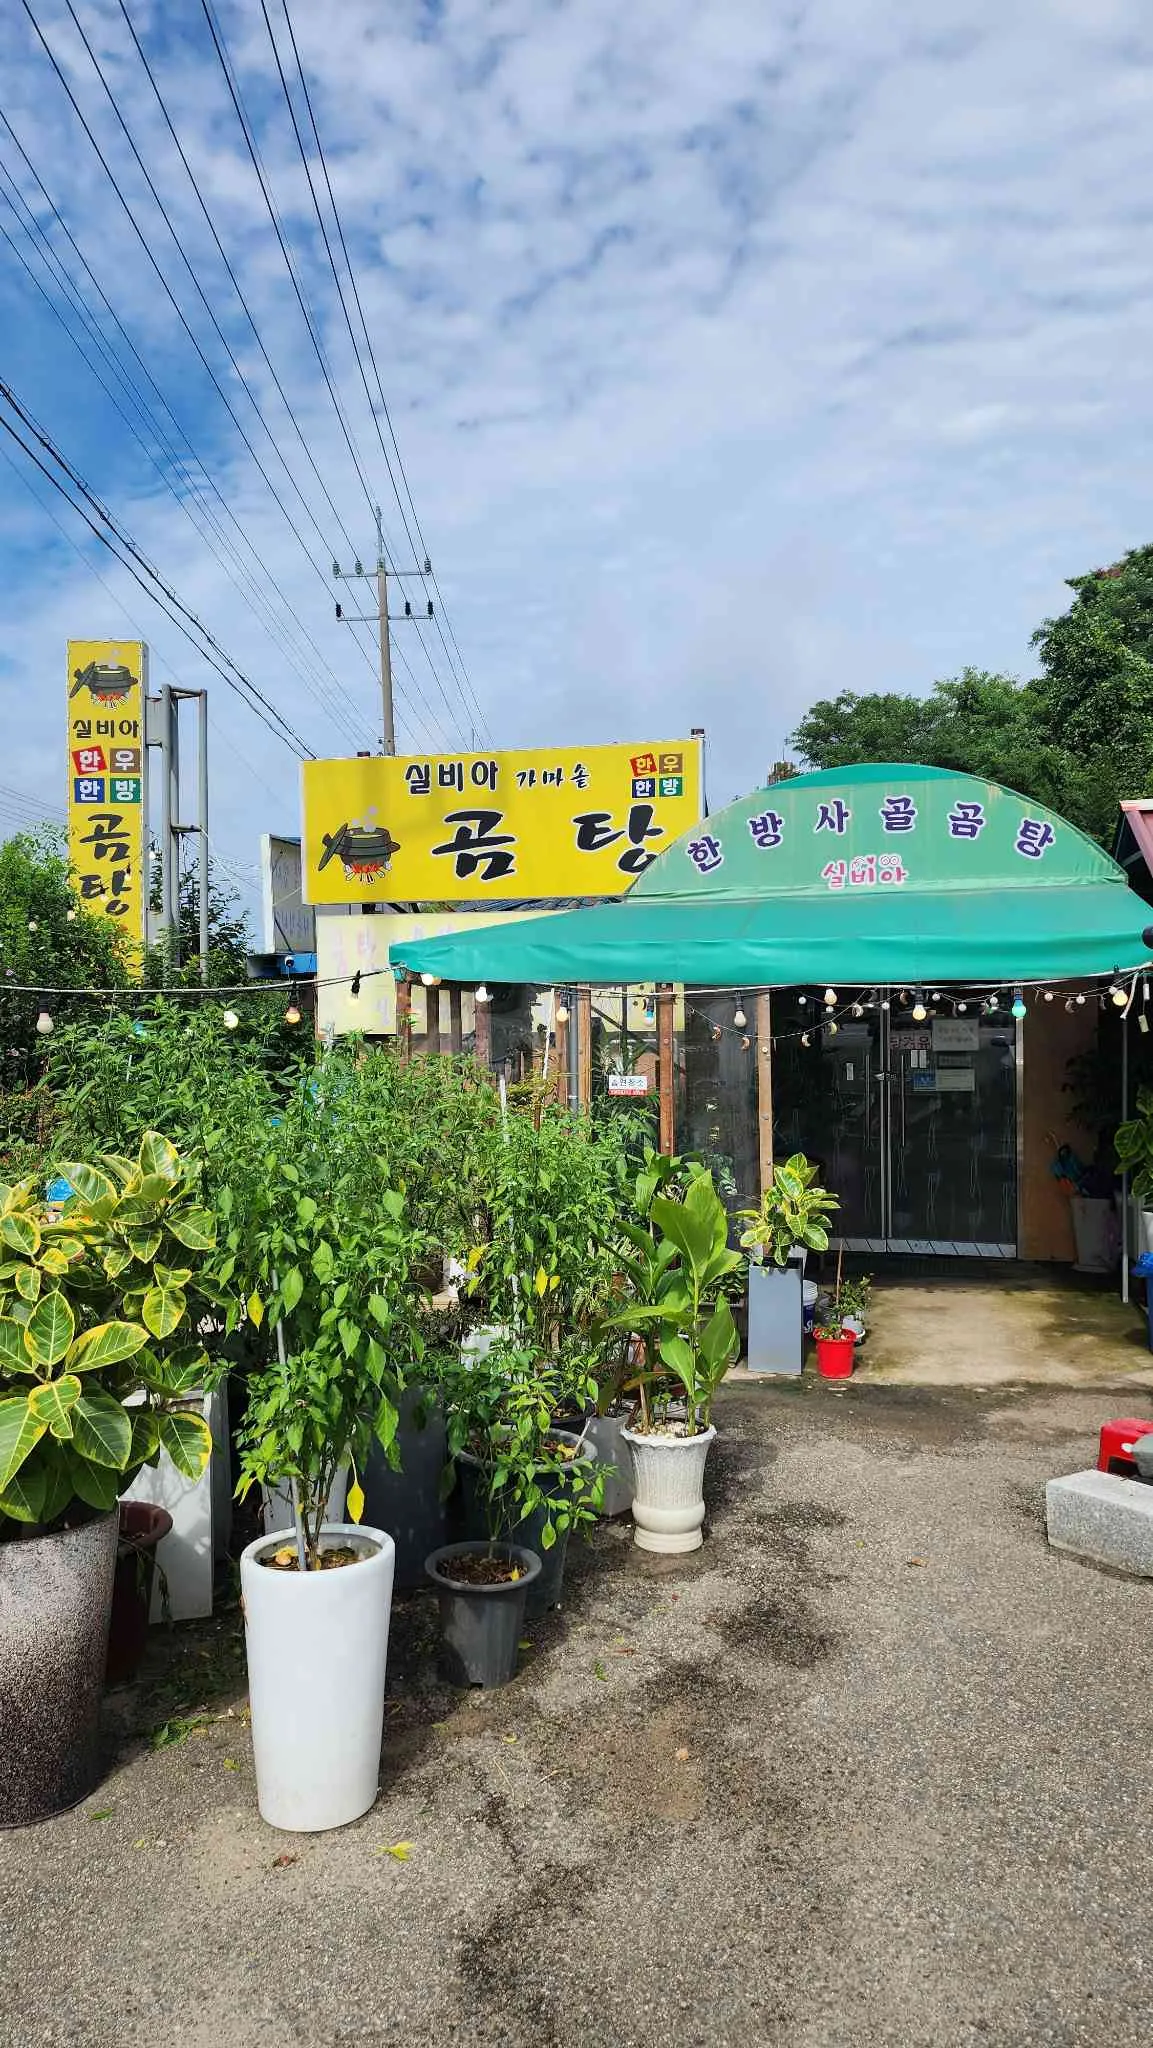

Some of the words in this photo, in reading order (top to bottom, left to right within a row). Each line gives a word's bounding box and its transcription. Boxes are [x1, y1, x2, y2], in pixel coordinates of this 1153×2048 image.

[72, 719, 139, 739] 실비아
[79, 750, 134, 772] 한우
[635, 756, 681, 773] 한우
[405, 761, 498, 793] 실비아
[516, 763, 590, 790] 가마솥
[635, 779, 679, 797] 한방
[80, 779, 137, 801] 한방
[432, 804, 664, 880] 곰탕
[79, 813, 131, 917] 곰탕
[823, 858, 907, 887] 실비아
